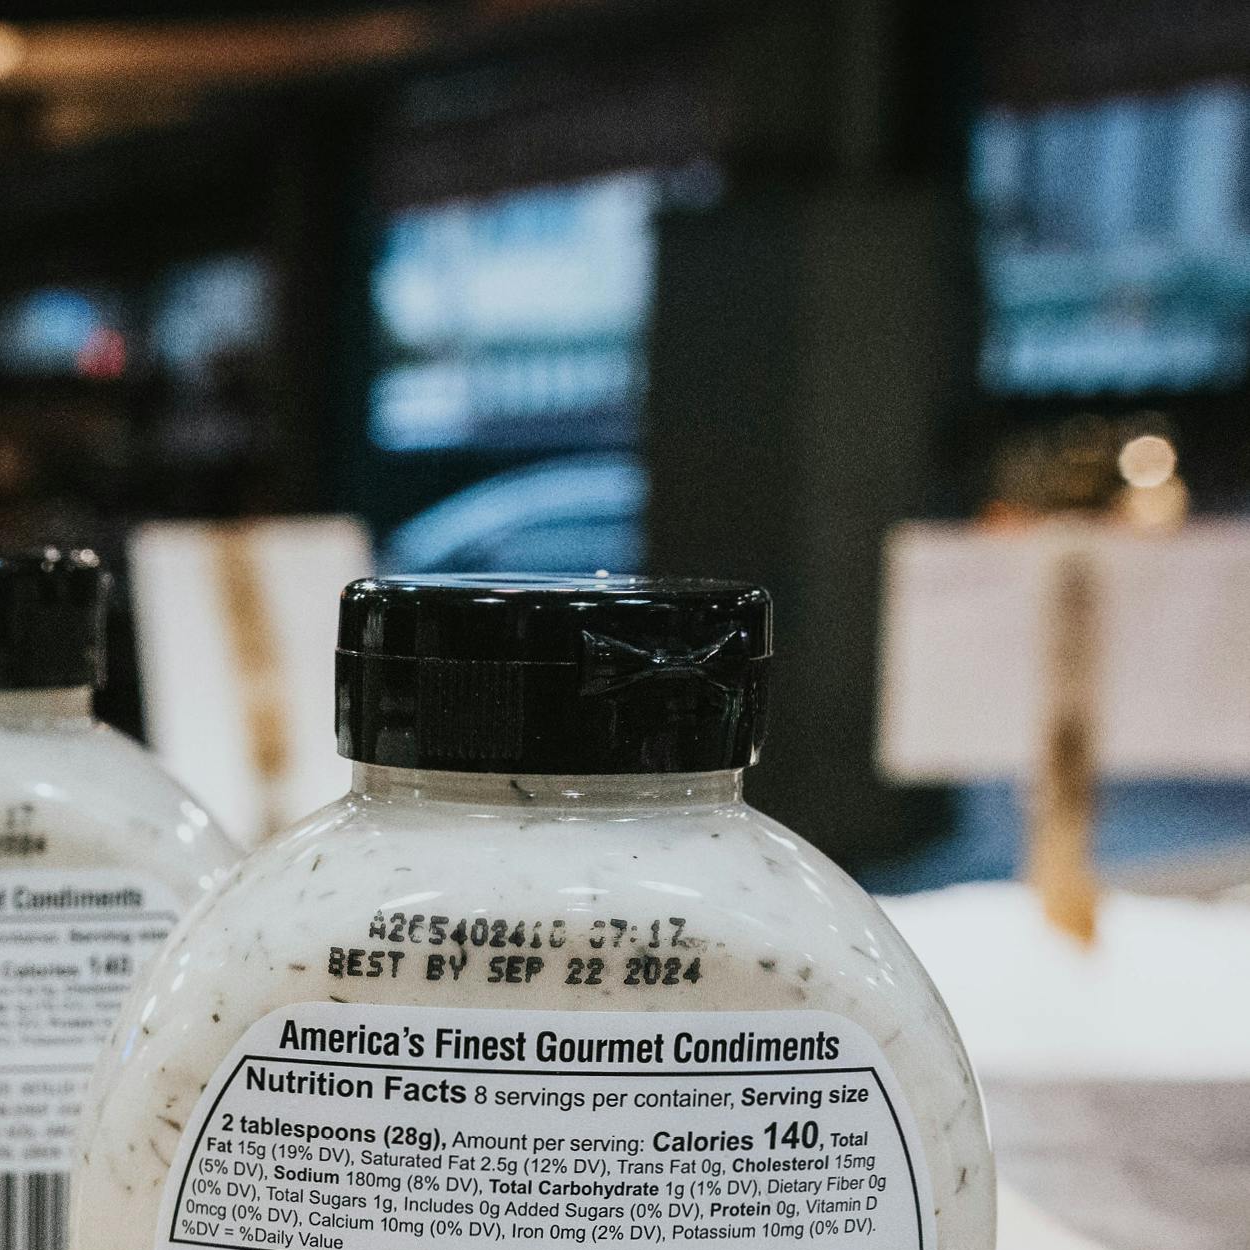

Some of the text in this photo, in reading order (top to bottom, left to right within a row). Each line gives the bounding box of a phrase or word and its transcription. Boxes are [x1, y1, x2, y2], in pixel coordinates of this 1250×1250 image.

[327, 947, 703, 984] BEST BY SEP 22 2024
[279, 1020, 840, 1063] America's Finest Gourmet Condiments
[247, 1066, 869, 1112] Nutrition Facts 8 servings per container, Serving size
[222, 1113, 868, 1156] 2 tablespoons (28g), Amount per serving: Calories 140, Total
[199, 1157, 886, 1200] (5% DV), Sodium 180mg (8% DV), Total Carbohydrate 1g (1% DV), Dietary Fiber 0g
